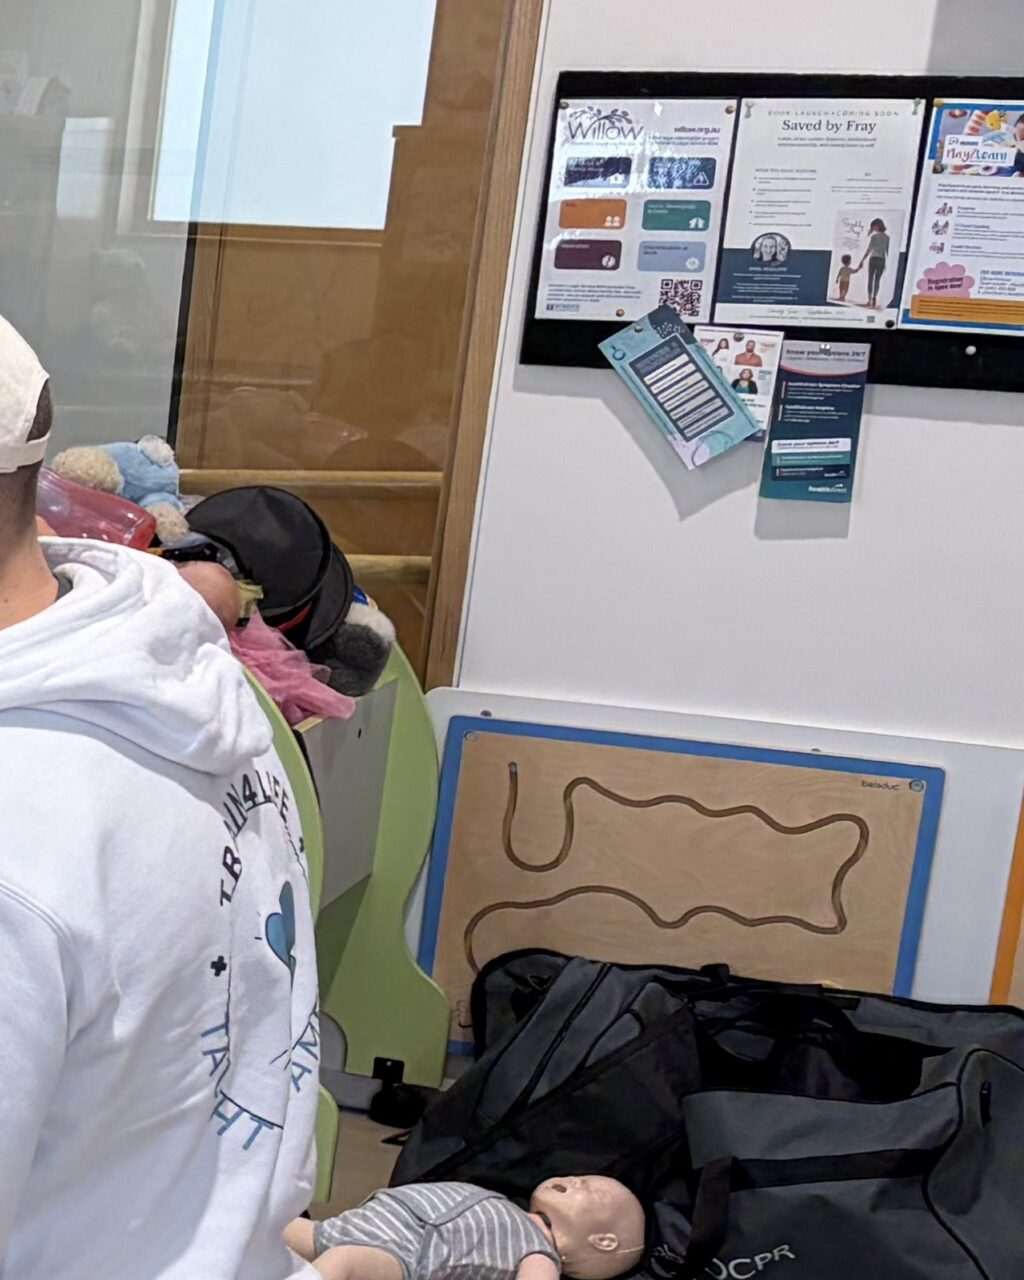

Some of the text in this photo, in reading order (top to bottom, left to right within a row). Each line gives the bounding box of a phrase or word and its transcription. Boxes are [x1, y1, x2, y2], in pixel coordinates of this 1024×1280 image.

[568, 119, 643, 140] Willow
[781, 119, 876, 134] Saved by Fray
